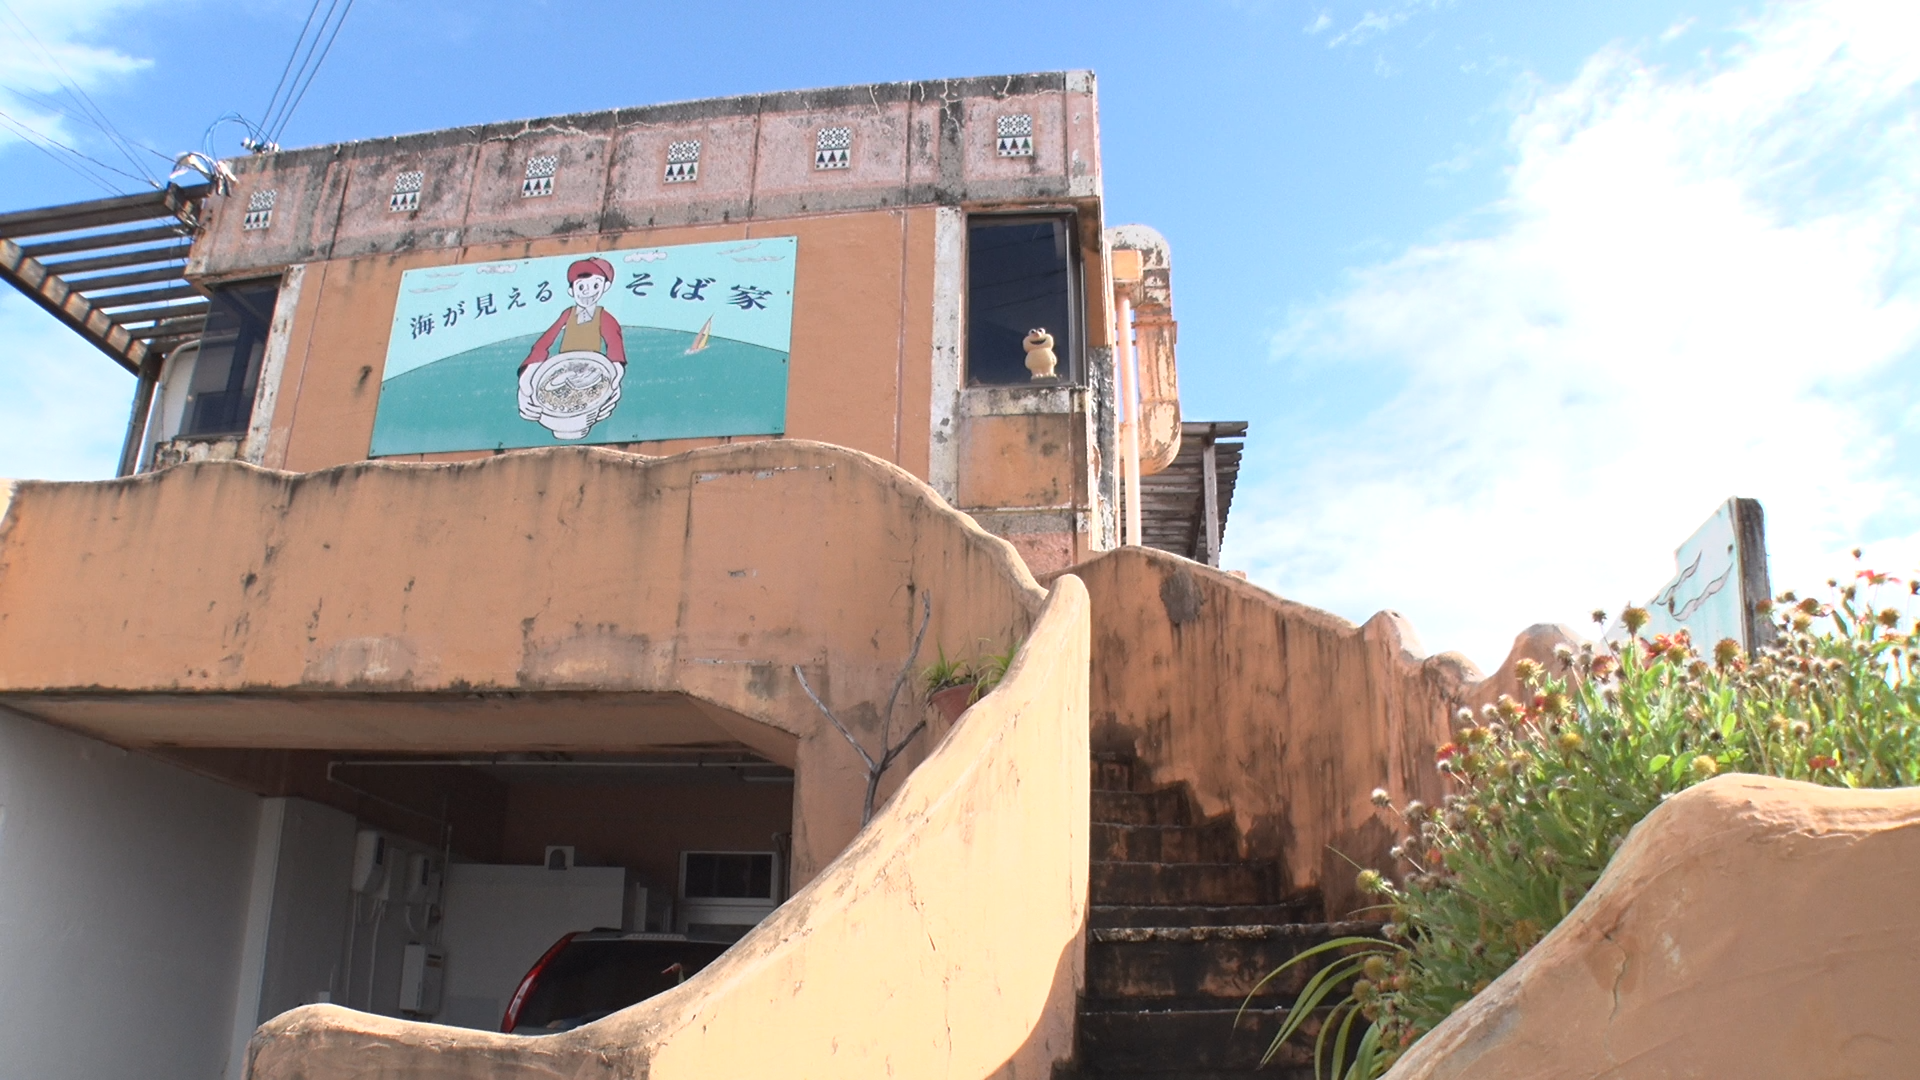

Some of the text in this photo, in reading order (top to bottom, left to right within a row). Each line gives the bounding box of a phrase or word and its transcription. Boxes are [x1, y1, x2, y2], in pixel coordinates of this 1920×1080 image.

[410, 272, 773, 340] 海が見える そば家
